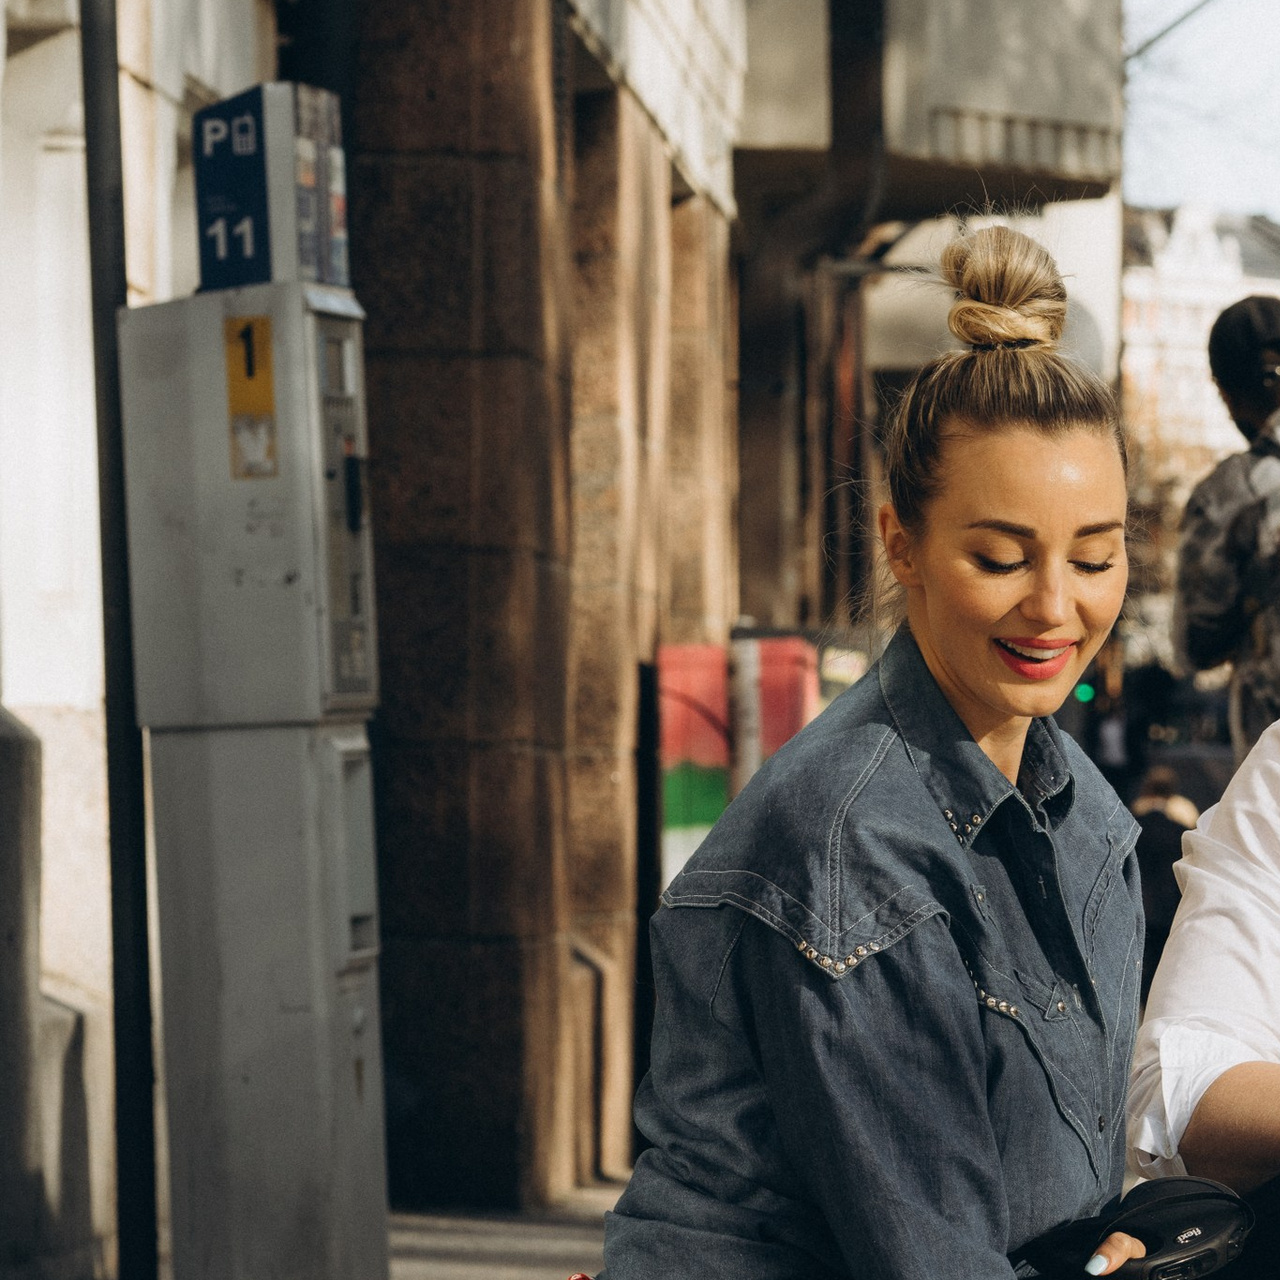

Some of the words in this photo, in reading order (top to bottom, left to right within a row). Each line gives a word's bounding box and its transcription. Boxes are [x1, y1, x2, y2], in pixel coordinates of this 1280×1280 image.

[203, 118, 229, 156] P
[205, 217, 255, 260] 11
[239, 323, 255, 380] 1
[1177, 1227, 1202, 1244] flexi
